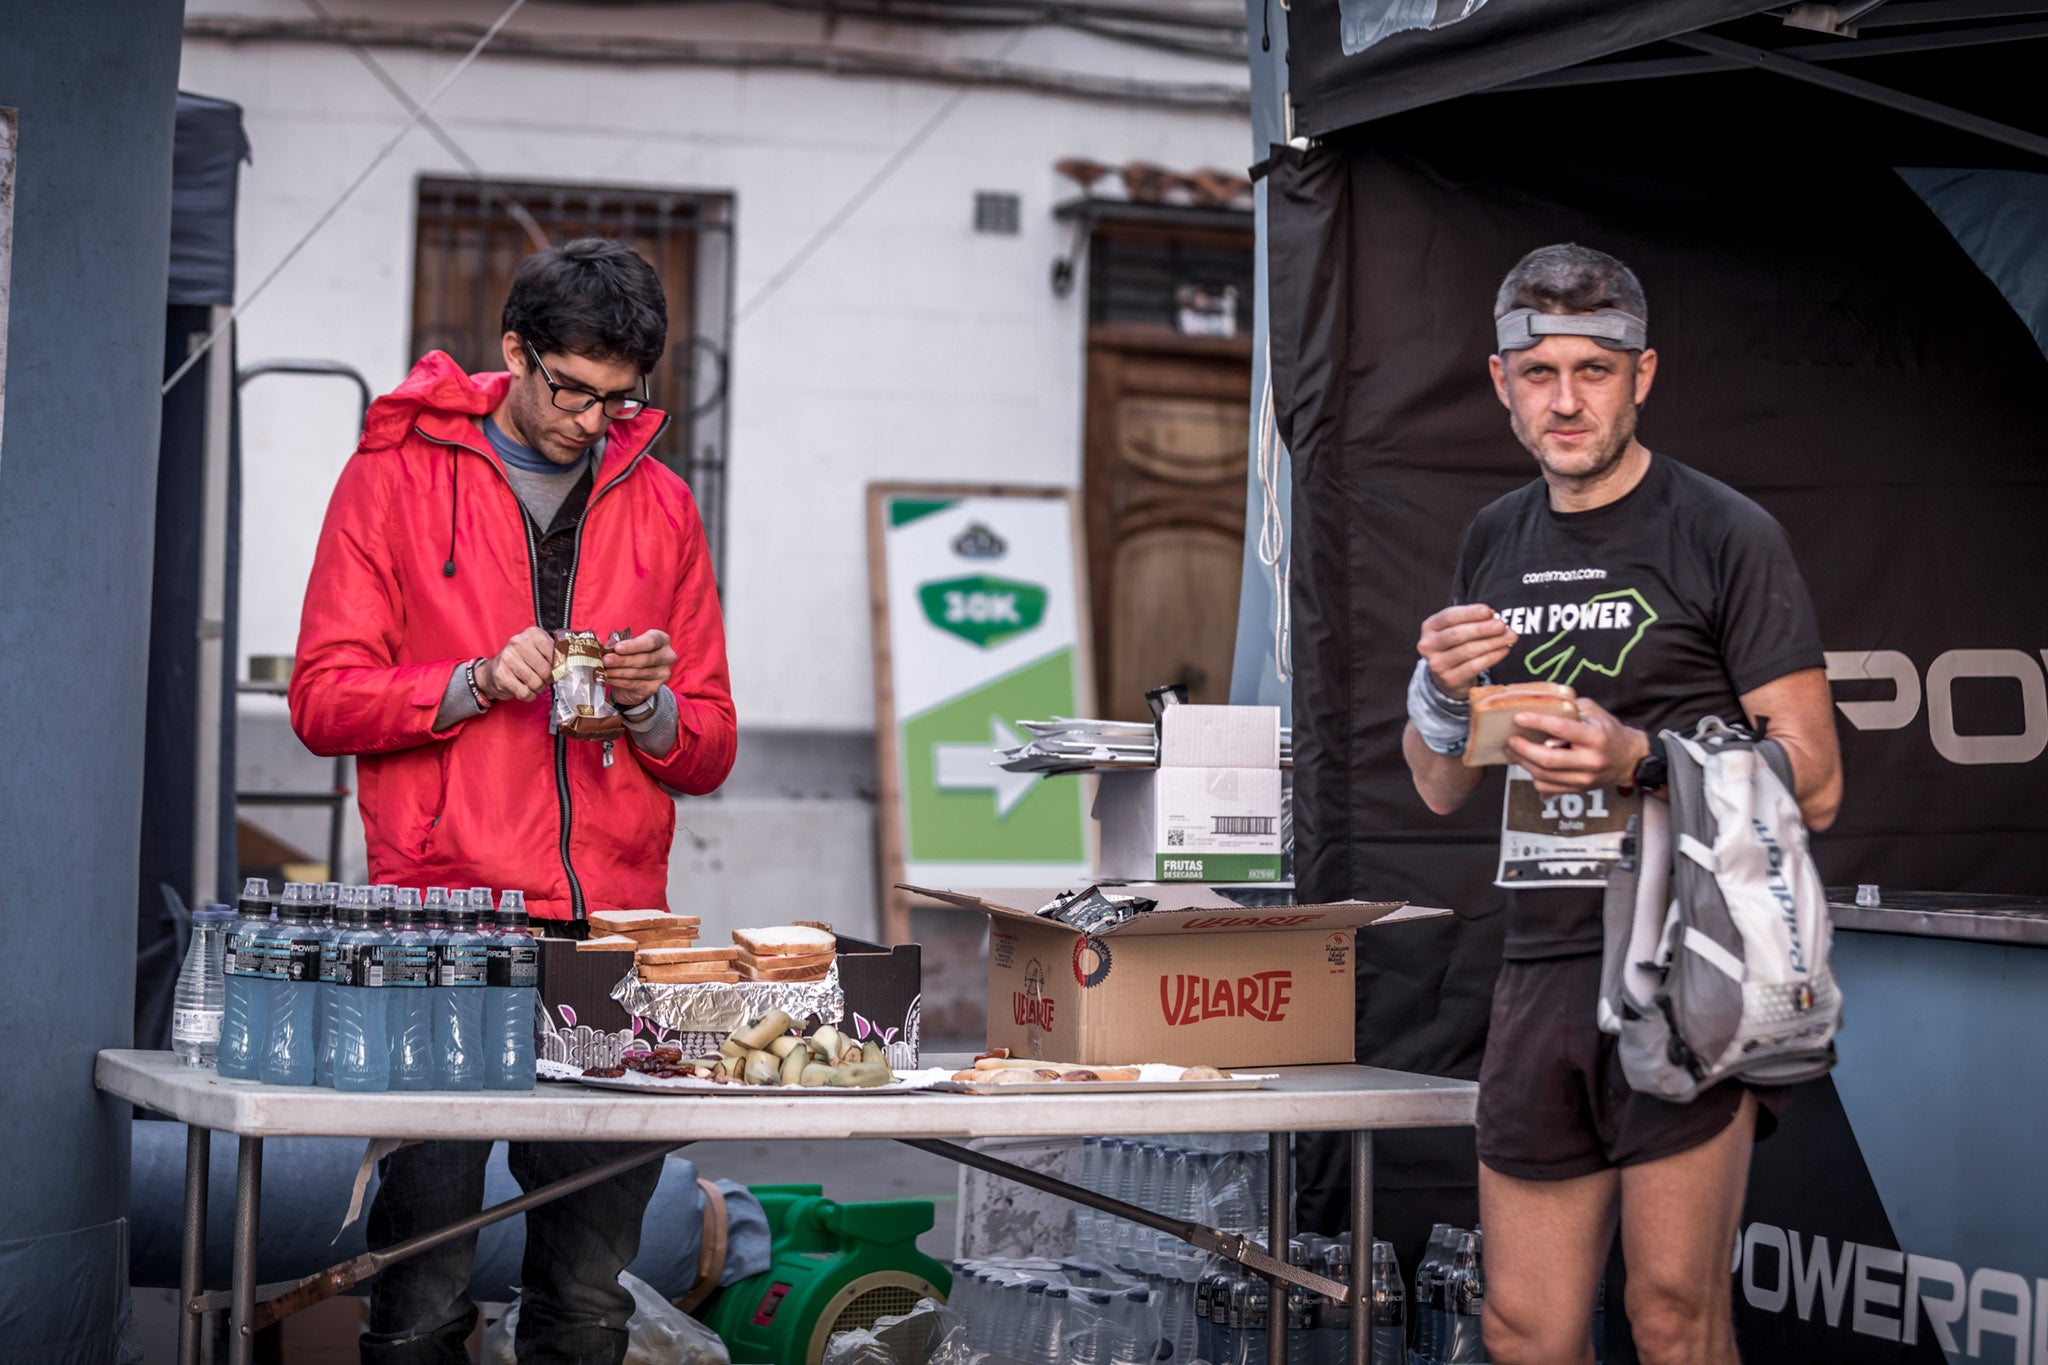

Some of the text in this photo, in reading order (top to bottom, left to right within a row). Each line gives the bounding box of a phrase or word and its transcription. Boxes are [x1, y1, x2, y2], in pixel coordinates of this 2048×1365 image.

[1494, 602, 1634, 635] EEN POWER
[1823, 648, 2048, 765] PO
[1163, 860, 1203, 871] FRUTAS
[1182, 914, 1326, 930] VELARTE
[1013, 991, 1055, 1033] VELARTE
[1160, 970, 1292, 1027] VELARTE
[1731, 1221, 2048, 1365] OWERA
